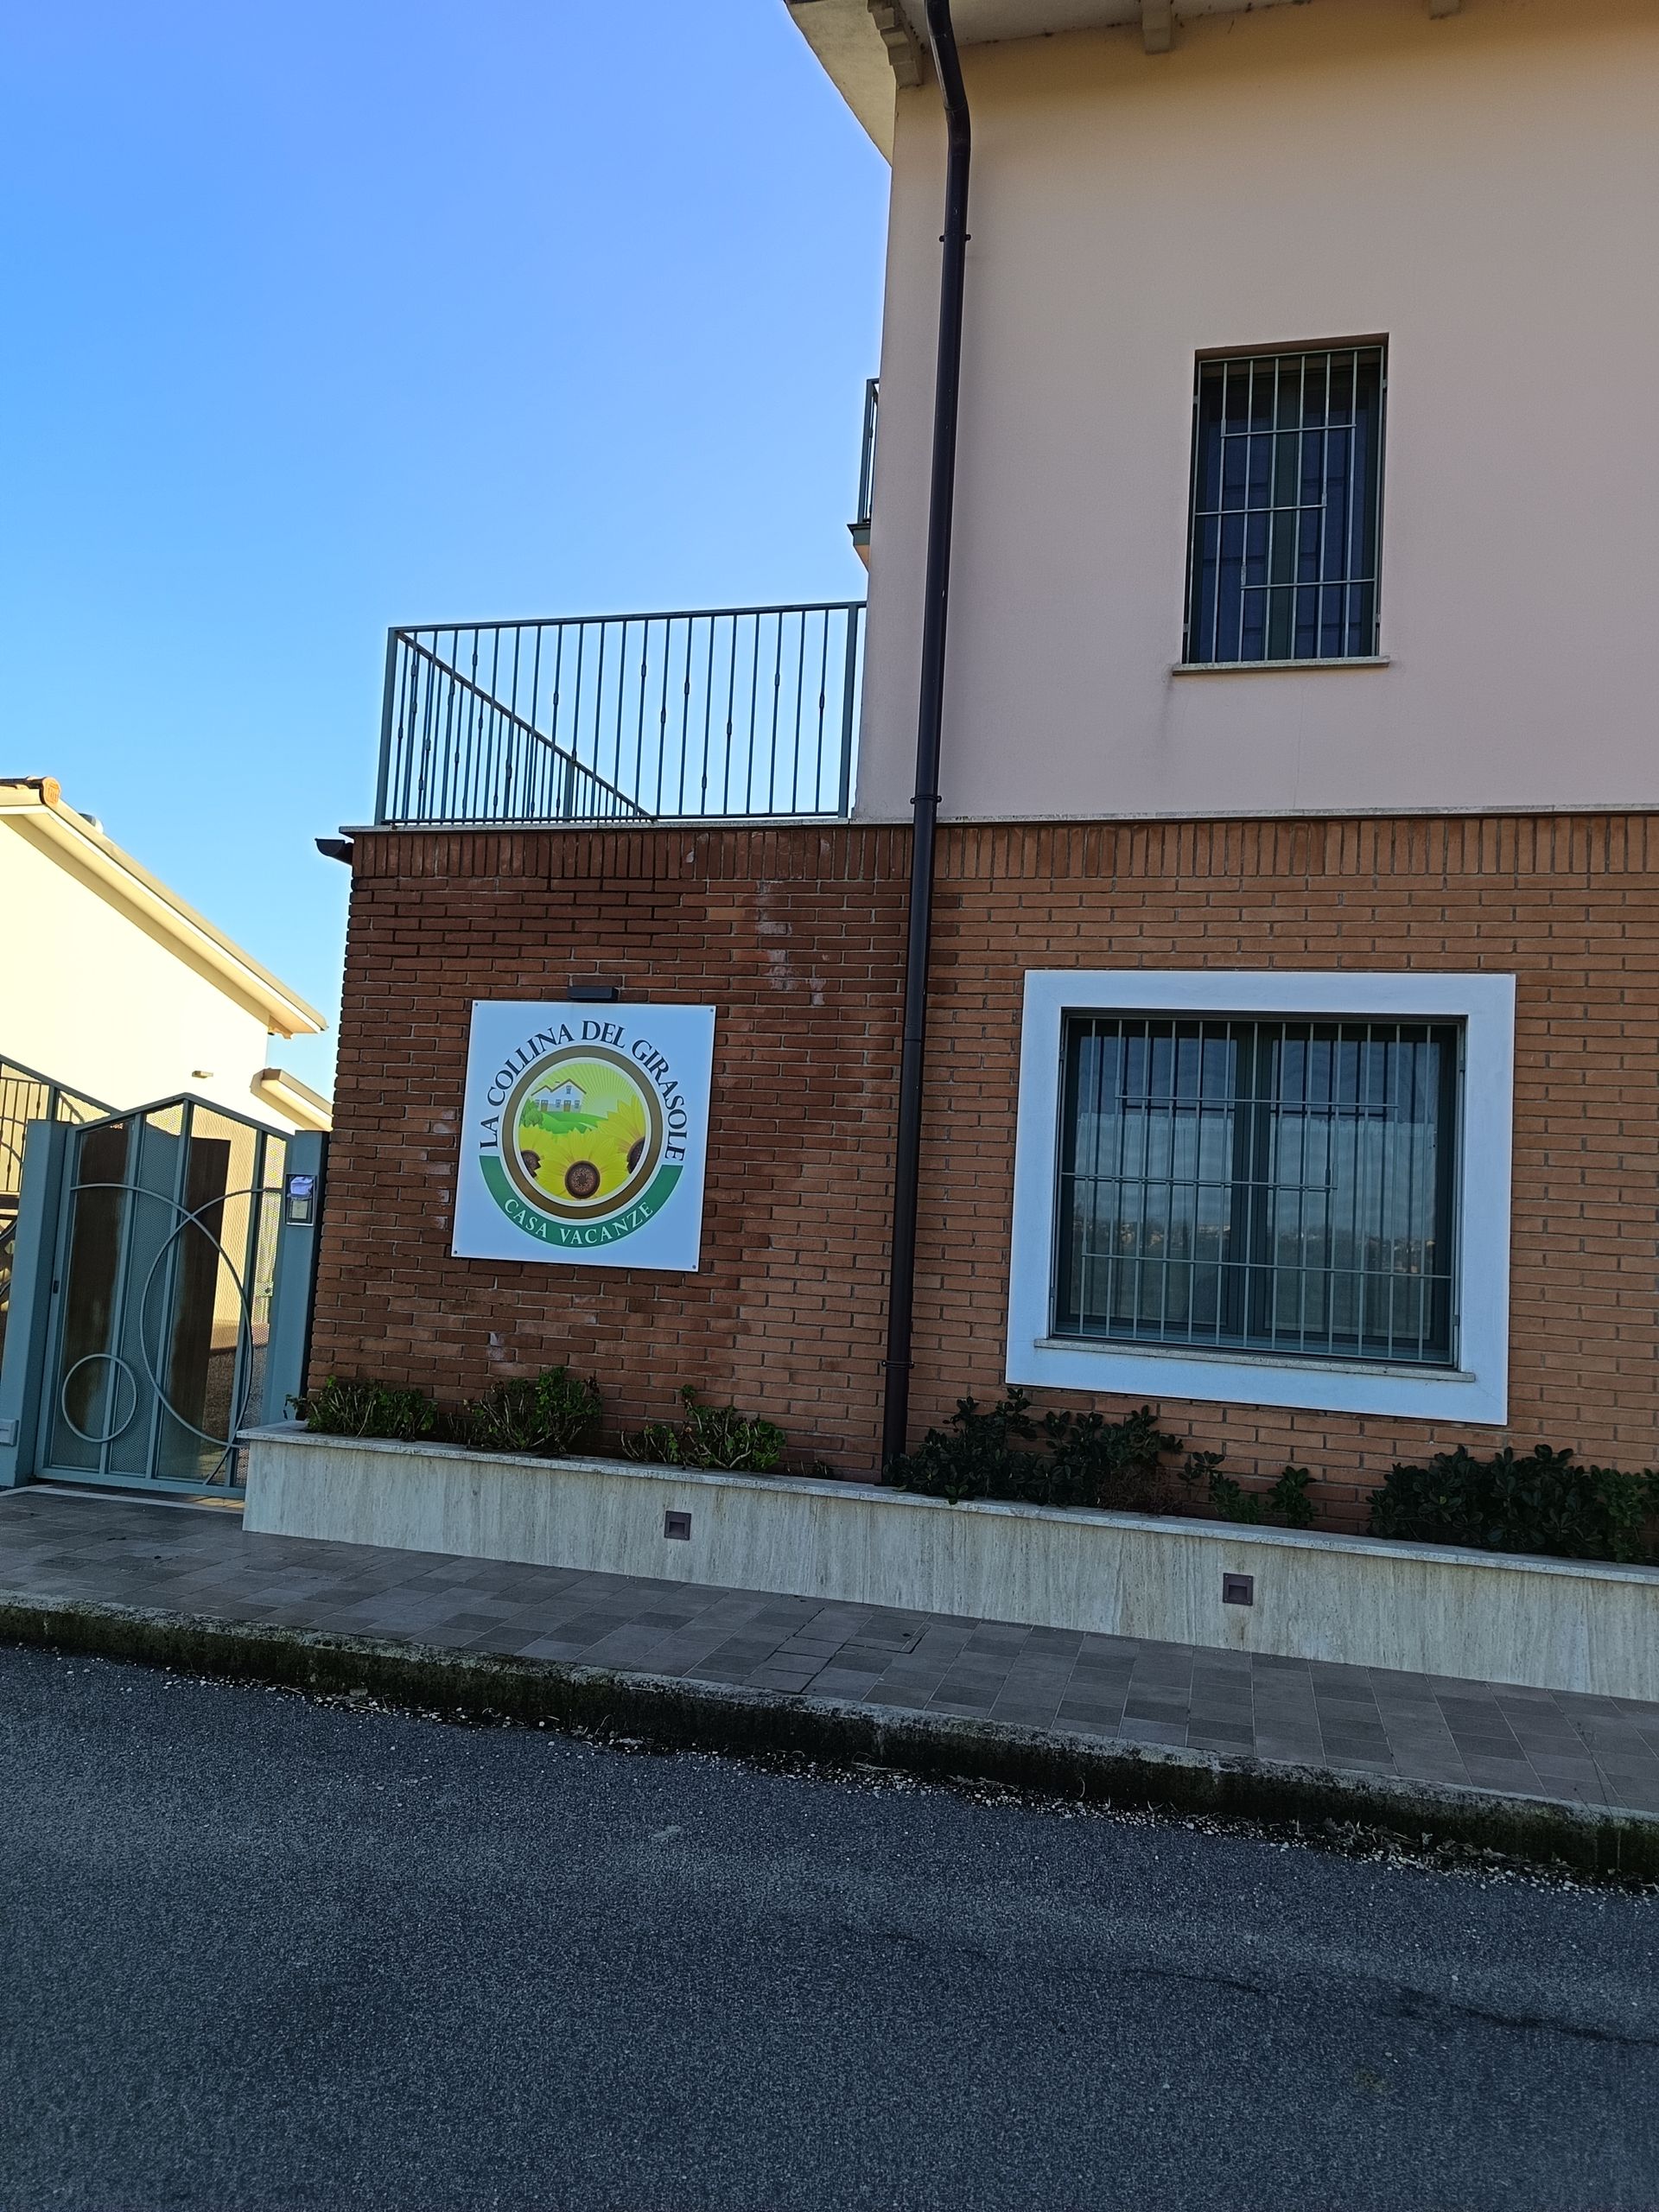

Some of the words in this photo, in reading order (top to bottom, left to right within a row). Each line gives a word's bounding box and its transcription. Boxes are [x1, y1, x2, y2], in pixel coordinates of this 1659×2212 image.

[581, 1020, 626, 1049] DEL
[486, 1023, 575, 1107] COLLINA
[632, 1039, 688, 1161] GIRASOLE
[480, 1115, 499, 1149] LA
[504, 1198, 549, 1239] CASA
[560, 1202, 653, 1245] VACANZE
